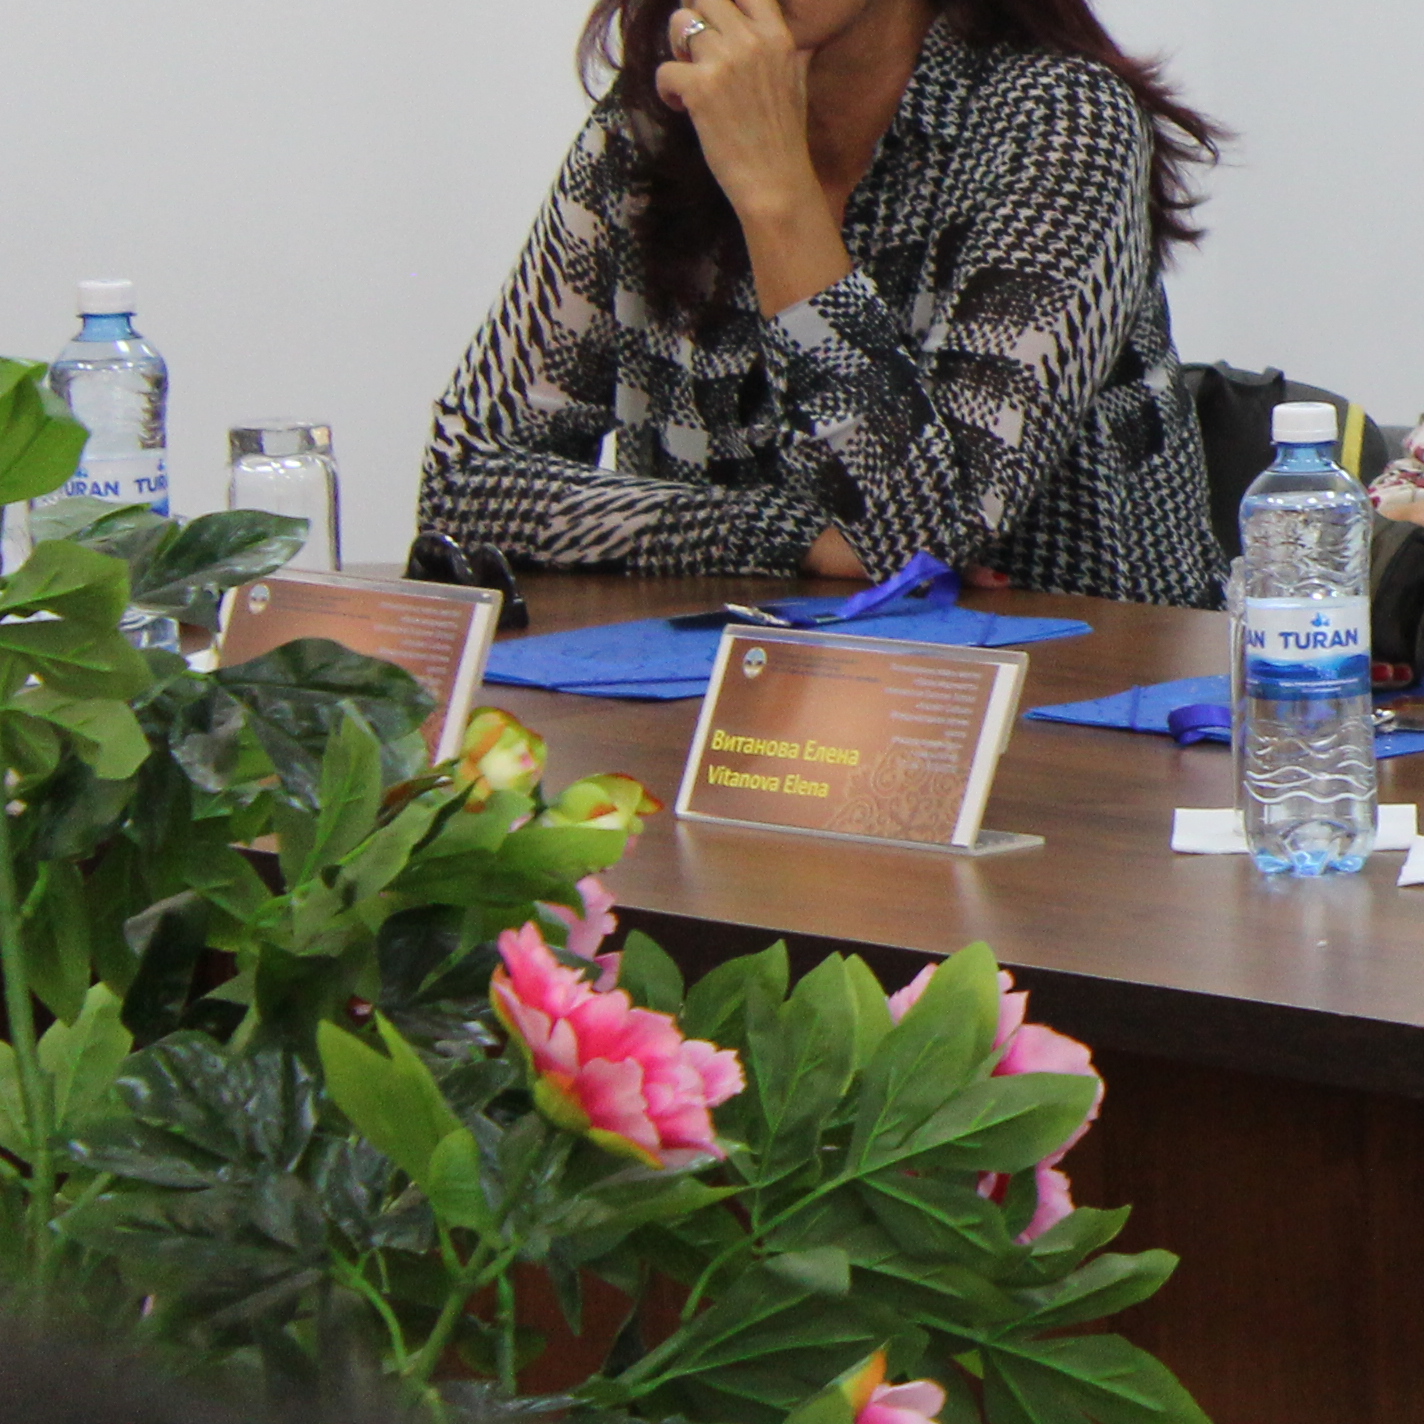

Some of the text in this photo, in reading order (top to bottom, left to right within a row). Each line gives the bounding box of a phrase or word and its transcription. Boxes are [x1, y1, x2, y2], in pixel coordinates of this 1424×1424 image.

[64, 480, 119, 496] URAN
[1279, 628, 1359, 649] TURAN
[711, 729, 860, 766] Витанова Елена
[708, 765, 830, 798] Vitanova Elena
